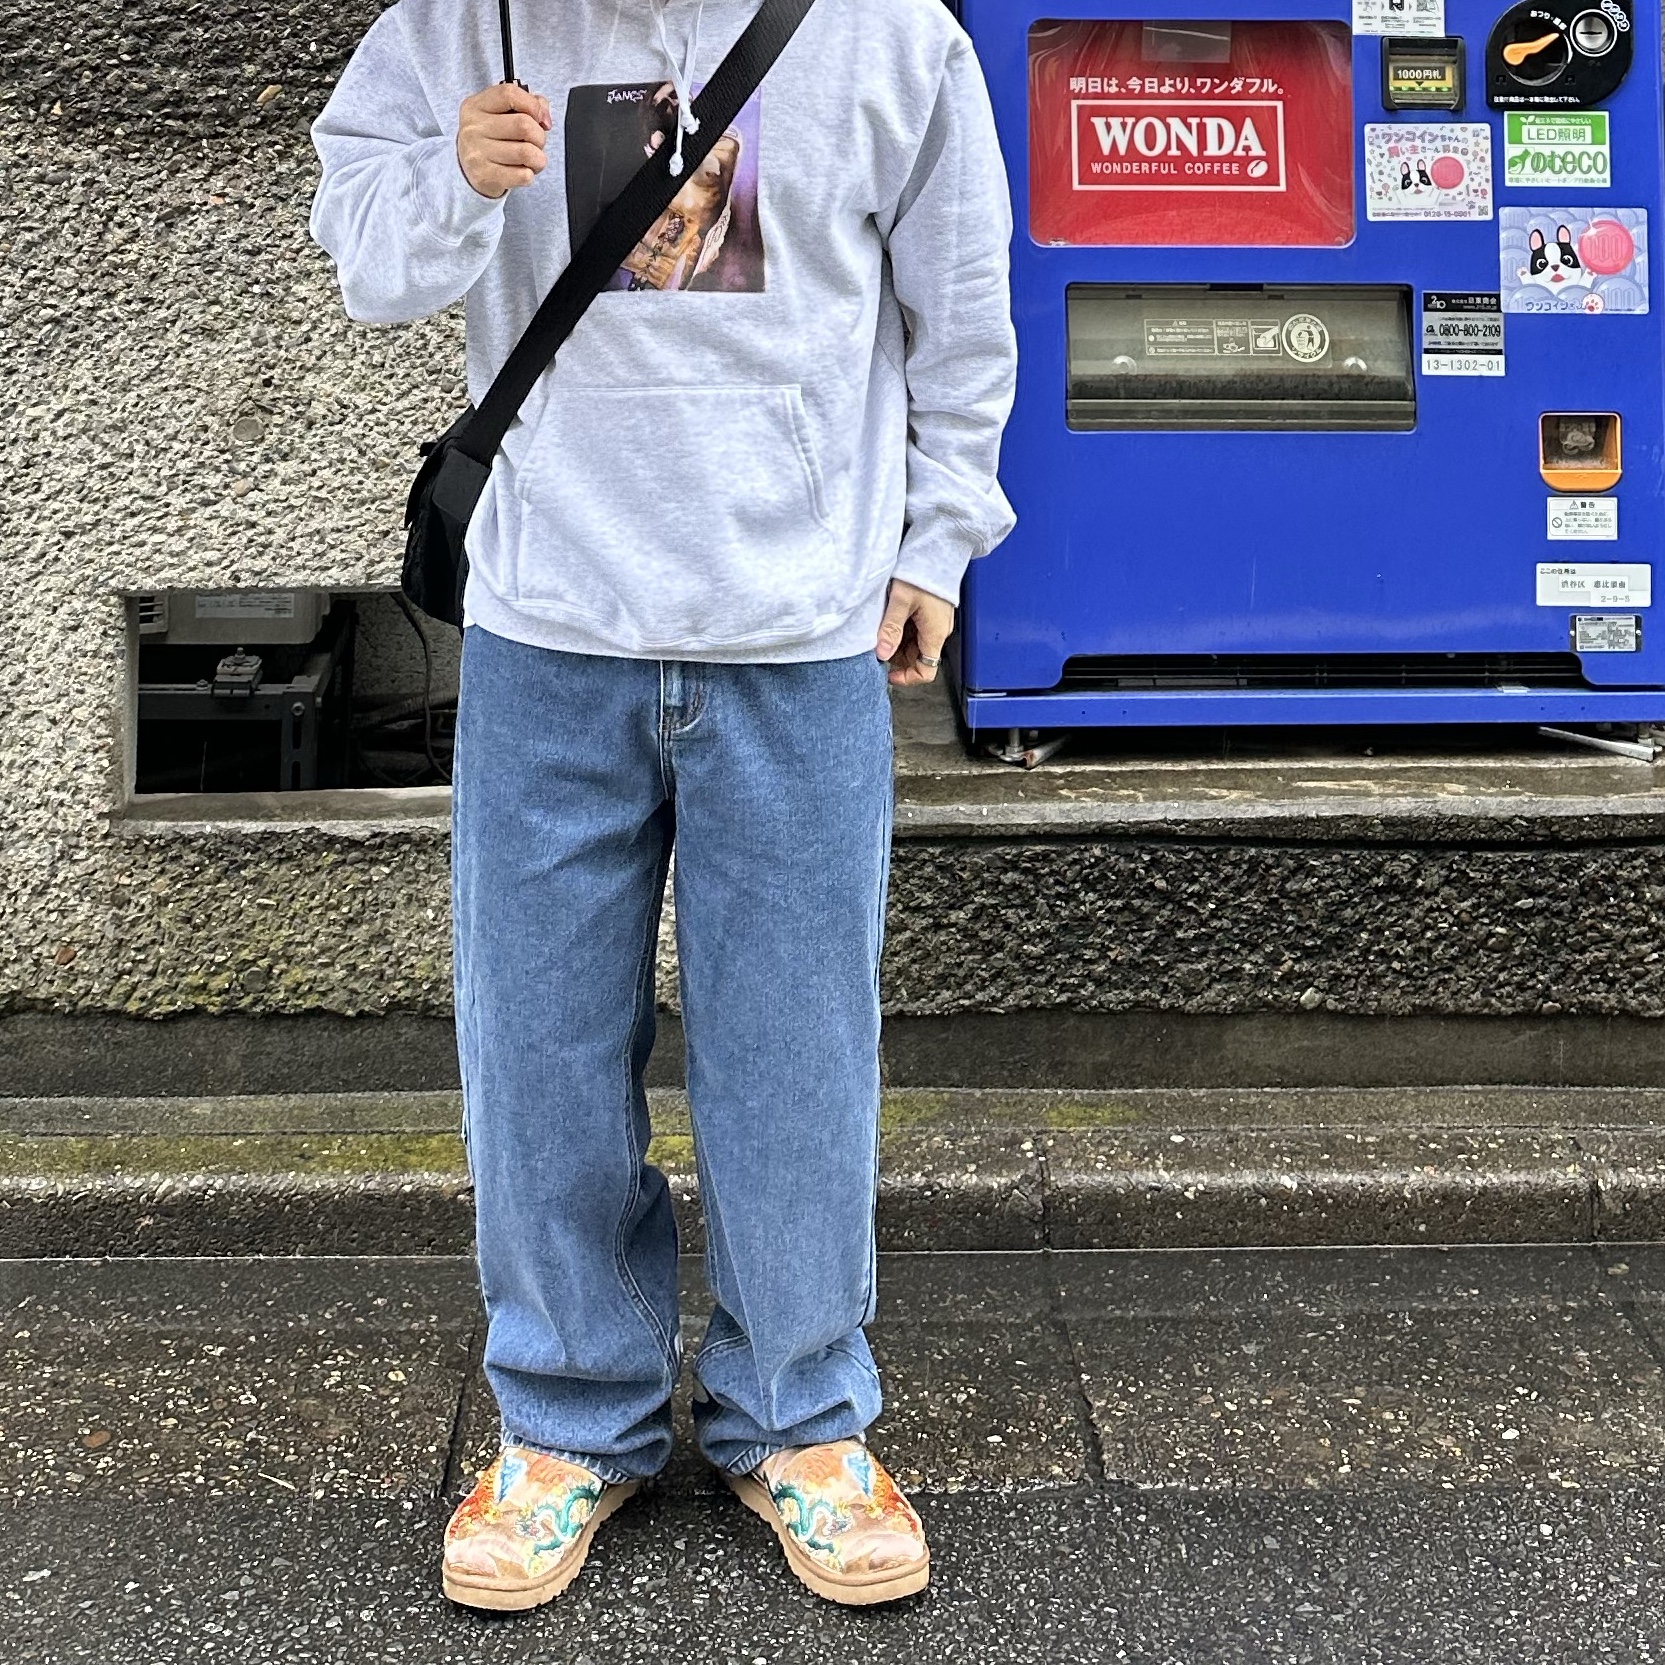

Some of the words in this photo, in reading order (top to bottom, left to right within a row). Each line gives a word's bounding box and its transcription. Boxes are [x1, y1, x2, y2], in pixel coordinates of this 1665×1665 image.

[1397, 69, 1442, 80] 1000円札
[1069, 76, 1284, 95] 明日は、今日より、ワンダフル。
[1090, 117, 1267, 157] WONDA
[1527, 128, 1586, 142] LED照明
[1091, 162, 1178, 175] WONDERFUL
[1185, 162, 1240, 175] COFFEE
[1426, 359, 1501, 371] 13-1302-01
